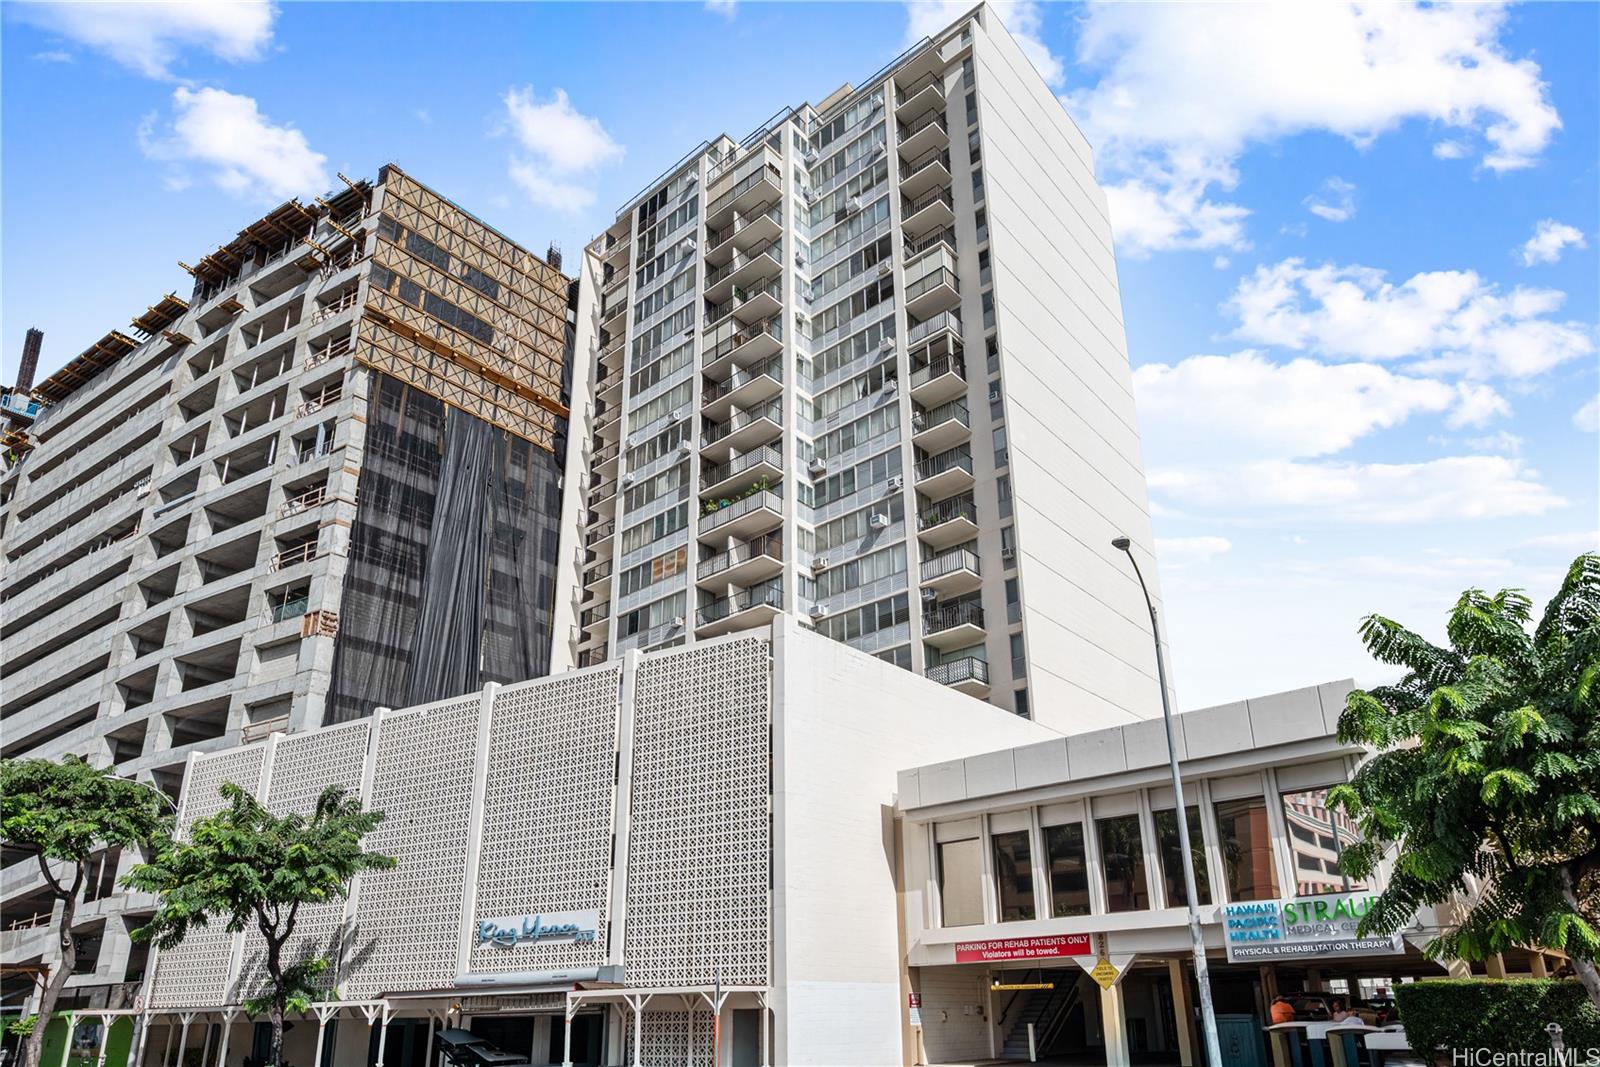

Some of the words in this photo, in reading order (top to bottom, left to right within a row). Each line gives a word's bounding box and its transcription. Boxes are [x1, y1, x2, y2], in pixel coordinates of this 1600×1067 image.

[479, 921, 518, 946] King
[1287, 923, 1339, 936] MEDICAL
[956, 942, 987, 952] PARKING
[988, 941, 1003, 950] FOR
[1004, 939, 1029, 949] REHAB
[1030, 937, 1067, 947] PATIENTS
[1067, 935, 1088, 945] ONLY
[1234, 947, 1273, 957] PHYSICAL
[1273, 946, 1280, 954] &
[1280, 942, 1349, 954] REHABILITATION
[1350, 940, 1391, 951] THERAPY
[982, 949, 1012, 959] Violators
[1013, 948, 1025, 957] will
[1026, 948, 1035, 956] be
[1036, 947, 1060, 956] towed.
